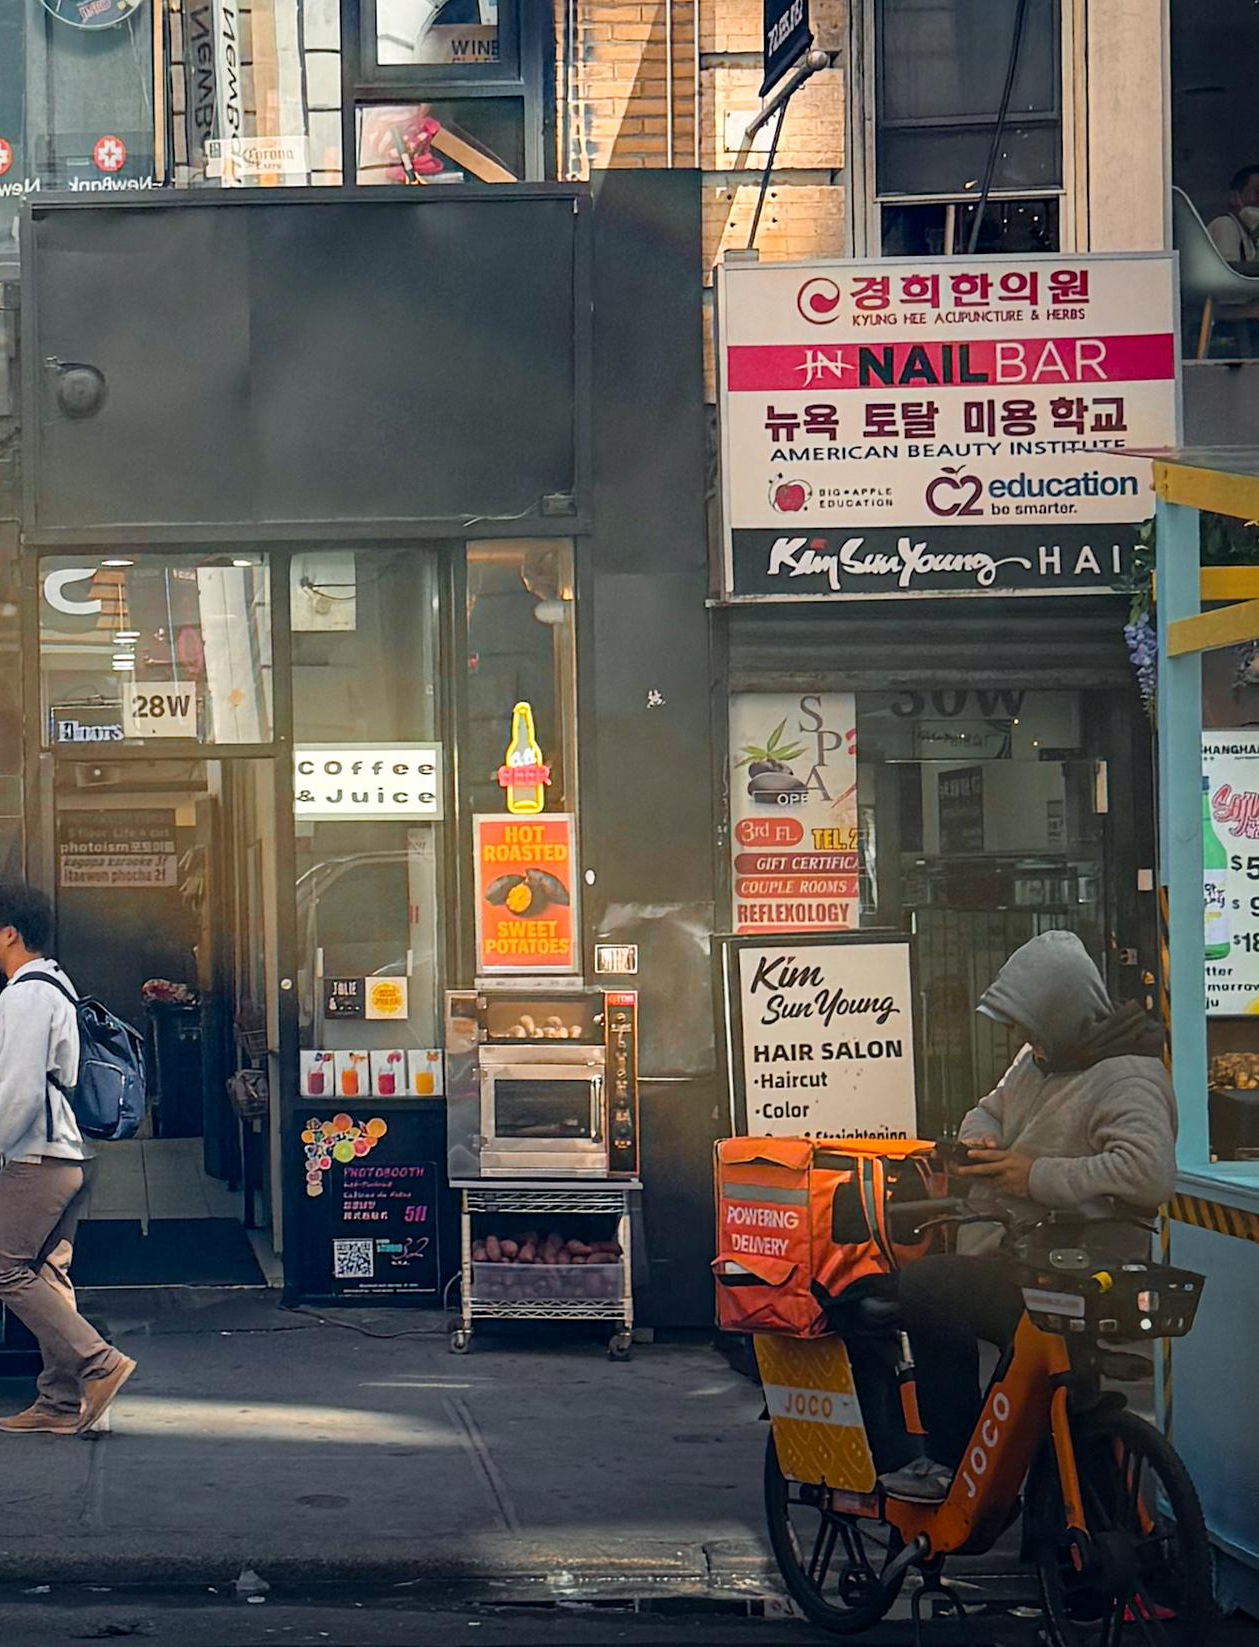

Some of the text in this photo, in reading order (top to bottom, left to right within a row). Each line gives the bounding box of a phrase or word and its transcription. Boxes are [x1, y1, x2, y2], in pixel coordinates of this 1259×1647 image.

[849, 269, 1091, 313] 경희한의원
[852, 308, 1086, 327] KYUNG HEE ACUPUNCTURE & HERBS
[764, 396, 1129, 442] 뉴욕 토탈 미용 학교
[769, 443, 899, 463] AMERICAN
[907, 442, 1002, 459] BEAUTY
[818, 488, 841, 498] BIG
[988, 468, 1139, 498] education
[818, 498, 894, 509] EDUCATION
[991, 503, 1011, 517] be
[132, 693, 192, 719] 28W
[297, 788, 437, 804] & Juice
[505, 825, 546, 845] HOT
[740, 820, 770, 843] 3rd
[774, 825, 799, 842] FL
[483, 843, 568, 863] ROASTED
[755, 855, 789, 871] GIFT
[740, 878, 848, 895] COUPLE ROOMS
[736, 902, 851, 924] REFLEXOLOGY
[496, 920, 557, 938] SWEET
[484, 938, 571, 956] POTATOES
[750, 955, 825, 994] Kim
[760, 987, 902, 1028] Sun Young
[753, 1039, 903, 1064] HAIR SALON
[760, 1070, 829, 1090] Haircut
[762, 1100, 811, 1119] Color
[343, 1166, 425, 1179] PHOTOBOOTH
[727, 1205, 800, 1230] POWERING
[731, 1233, 790, 1256] DELIVERY
[784, 1392, 834, 1419] JOCO
[963, 1390, 1012, 1501] JOCO
